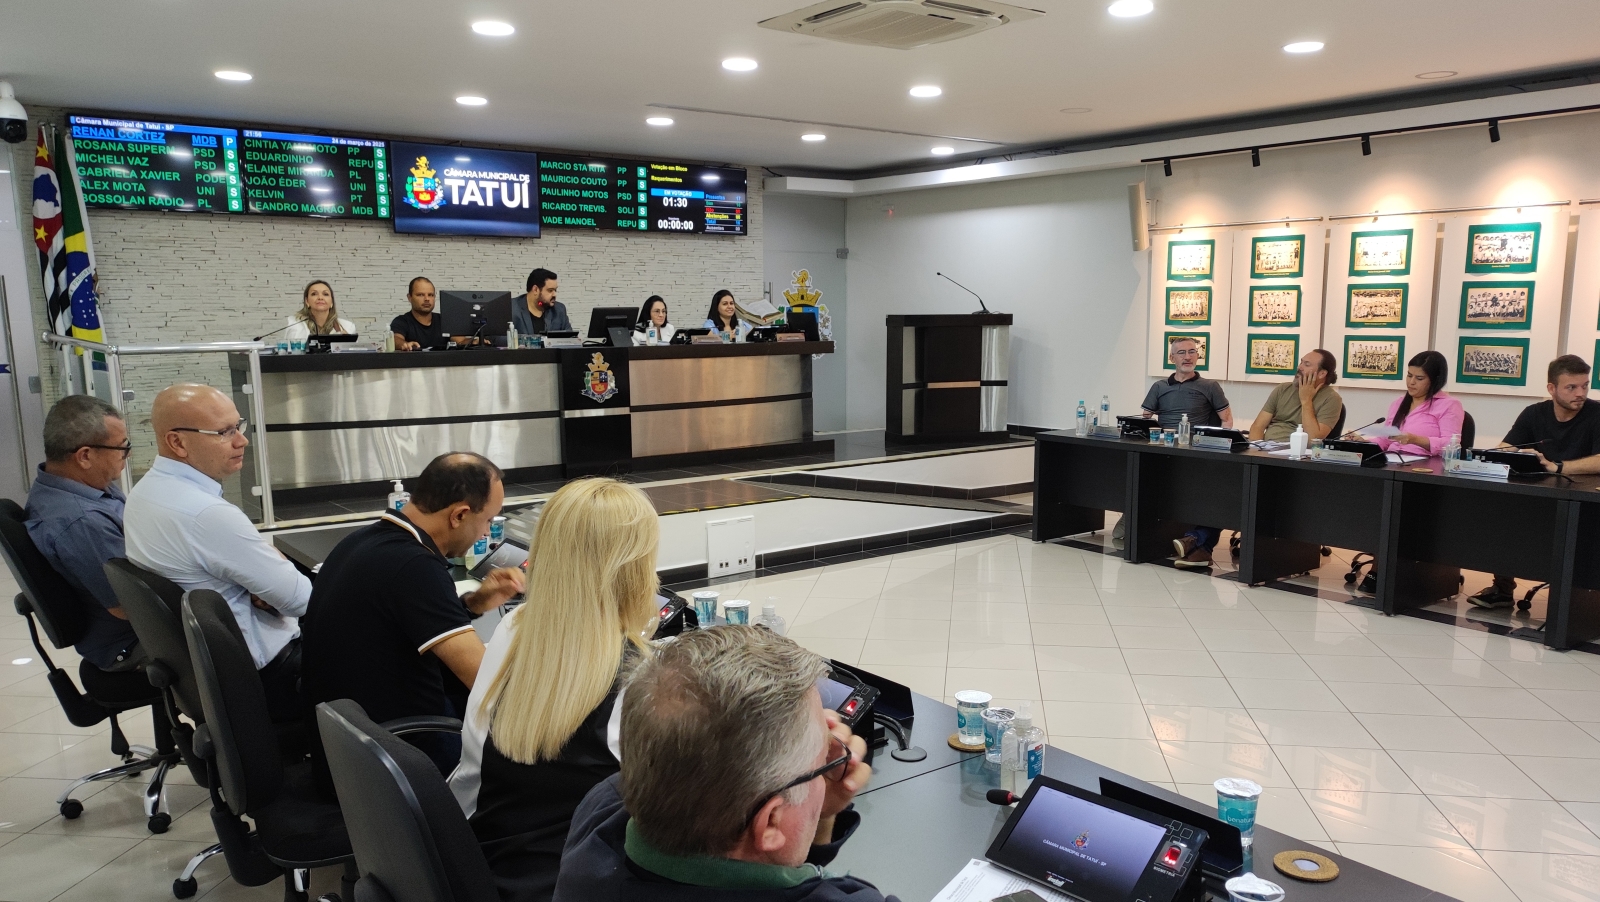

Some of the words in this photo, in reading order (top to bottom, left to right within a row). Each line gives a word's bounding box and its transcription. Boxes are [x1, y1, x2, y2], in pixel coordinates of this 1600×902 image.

[76, 117, 102, 126] Câmara
[102, 119, 134, 128] Municipal
[73, 126, 114, 138] RENAN
[118, 130, 165, 141] CORTEZ
[192, 135, 217, 145] MDB
[226, 138, 233, 146] P
[74, 140, 125, 152] ROSANA
[193, 148, 215, 158] PSD
[227, 151, 234, 159] S
[245, 138, 279, 149] CINTIA
[348, 147, 360, 155] PP
[377, 148, 382, 157] S
[75, 153, 124, 164] MICHELI
[127, 157, 149, 167] VAZ
[194, 161, 217, 171] PSD
[228, 163, 236, 171] S
[246, 152, 314, 164] EDUARDINHO
[349, 159, 374, 168] REPU
[377, 160, 383, 169] S
[77, 166, 138, 179] GABRIELA
[140, 170, 181, 181] XAVIER
[195, 174, 226, 183] PODE
[229, 175, 237, 184] S
[247, 164, 285, 175] ELAINE
[288, 167, 334, 178] MIRANDA
[350, 171, 361, 179] PL
[378, 172, 384, 181] S
[444, 167, 478, 178] CÂMARA
[479, 170, 519, 182] MUNICIPAL
[520, 174, 530, 182] DE
[540, 161, 571, 170] MARCIO
[573, 163, 587, 172] STA
[639, 168, 644, 176] S
[80, 179, 109, 190] ALEX
[112, 181, 146, 192] MOTA
[197, 187, 215, 196] UNI
[230, 188, 238, 197] S
[247, 175, 276, 186] JOÃO
[279, 177, 306, 187] ÉDER
[350, 183, 366, 191] UNI
[379, 184, 385, 193] S
[541, 174, 579, 184] MAURICIO
[581, 177, 607, 186] COUTO
[640, 181, 645, 189] S
[83, 193, 146, 205] BOSSOLAN
[149, 196, 184, 207] RADIO
[198, 199, 212, 208] PL
[232, 200, 239, 209] S
[248, 189, 284, 199] KELVIN
[351, 195, 363, 203] PT
[380, 196, 386, 204] S
[444, 178, 530, 209] TATUÍ
[541, 188, 580, 197] PAULINHO
[582, 190, 608, 199] MOTOS
[249, 201, 299, 211] LEANDRO
[352, 206, 373, 215] MDB
[381, 207, 387, 216] S
[542, 202, 577, 211] RICARDO
[579, 204, 607, 213] TREVIS.
[617, 206, 634, 214] SOLI
[662, 197, 687, 207] 01:30
[543, 216, 562, 224] VADE
[564, 217, 596, 226] MANOEL
[658, 219, 694, 230] 00:00:00
